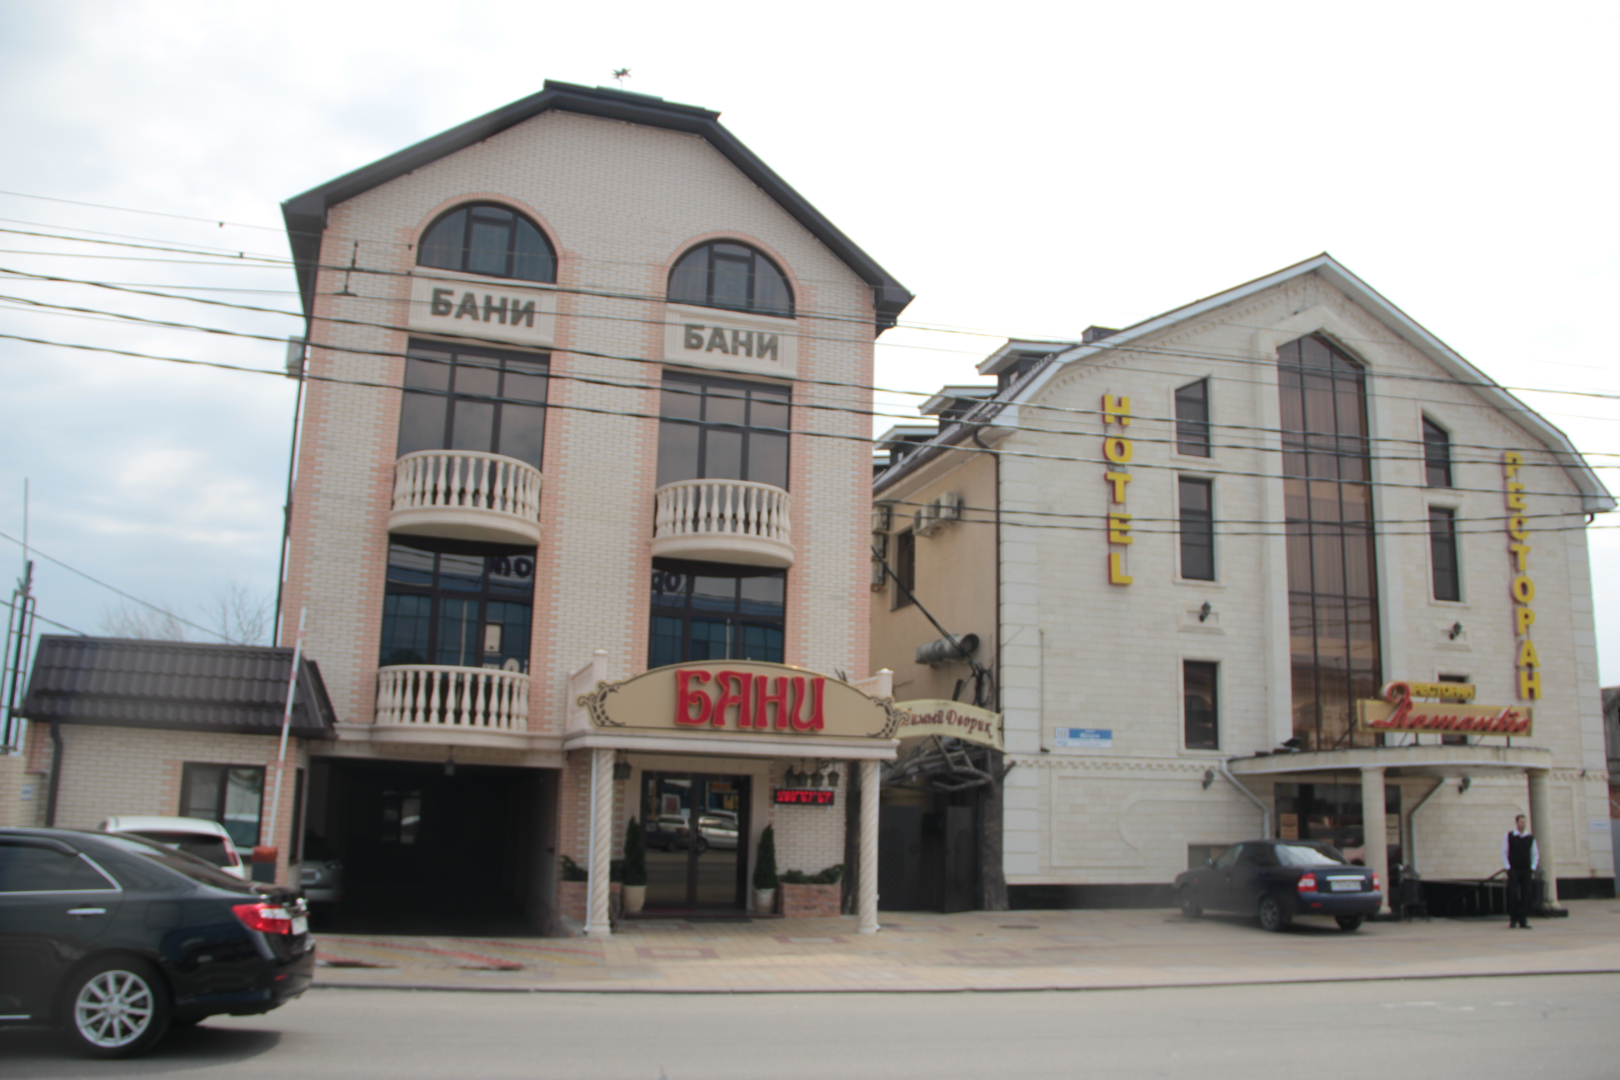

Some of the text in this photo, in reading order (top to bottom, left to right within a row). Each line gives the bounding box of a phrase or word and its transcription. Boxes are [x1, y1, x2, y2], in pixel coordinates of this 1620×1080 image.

[430, 287, 537, 328] БАНИ
[682, 323, 780, 361] БАНИ
[1101, 394, 1133, 586] HOTEL
[1501, 450, 1542, 700] РЕСТОРАН
[674, 669, 826, 731] БАНИ
[946, 708, 993, 739] Дворик
